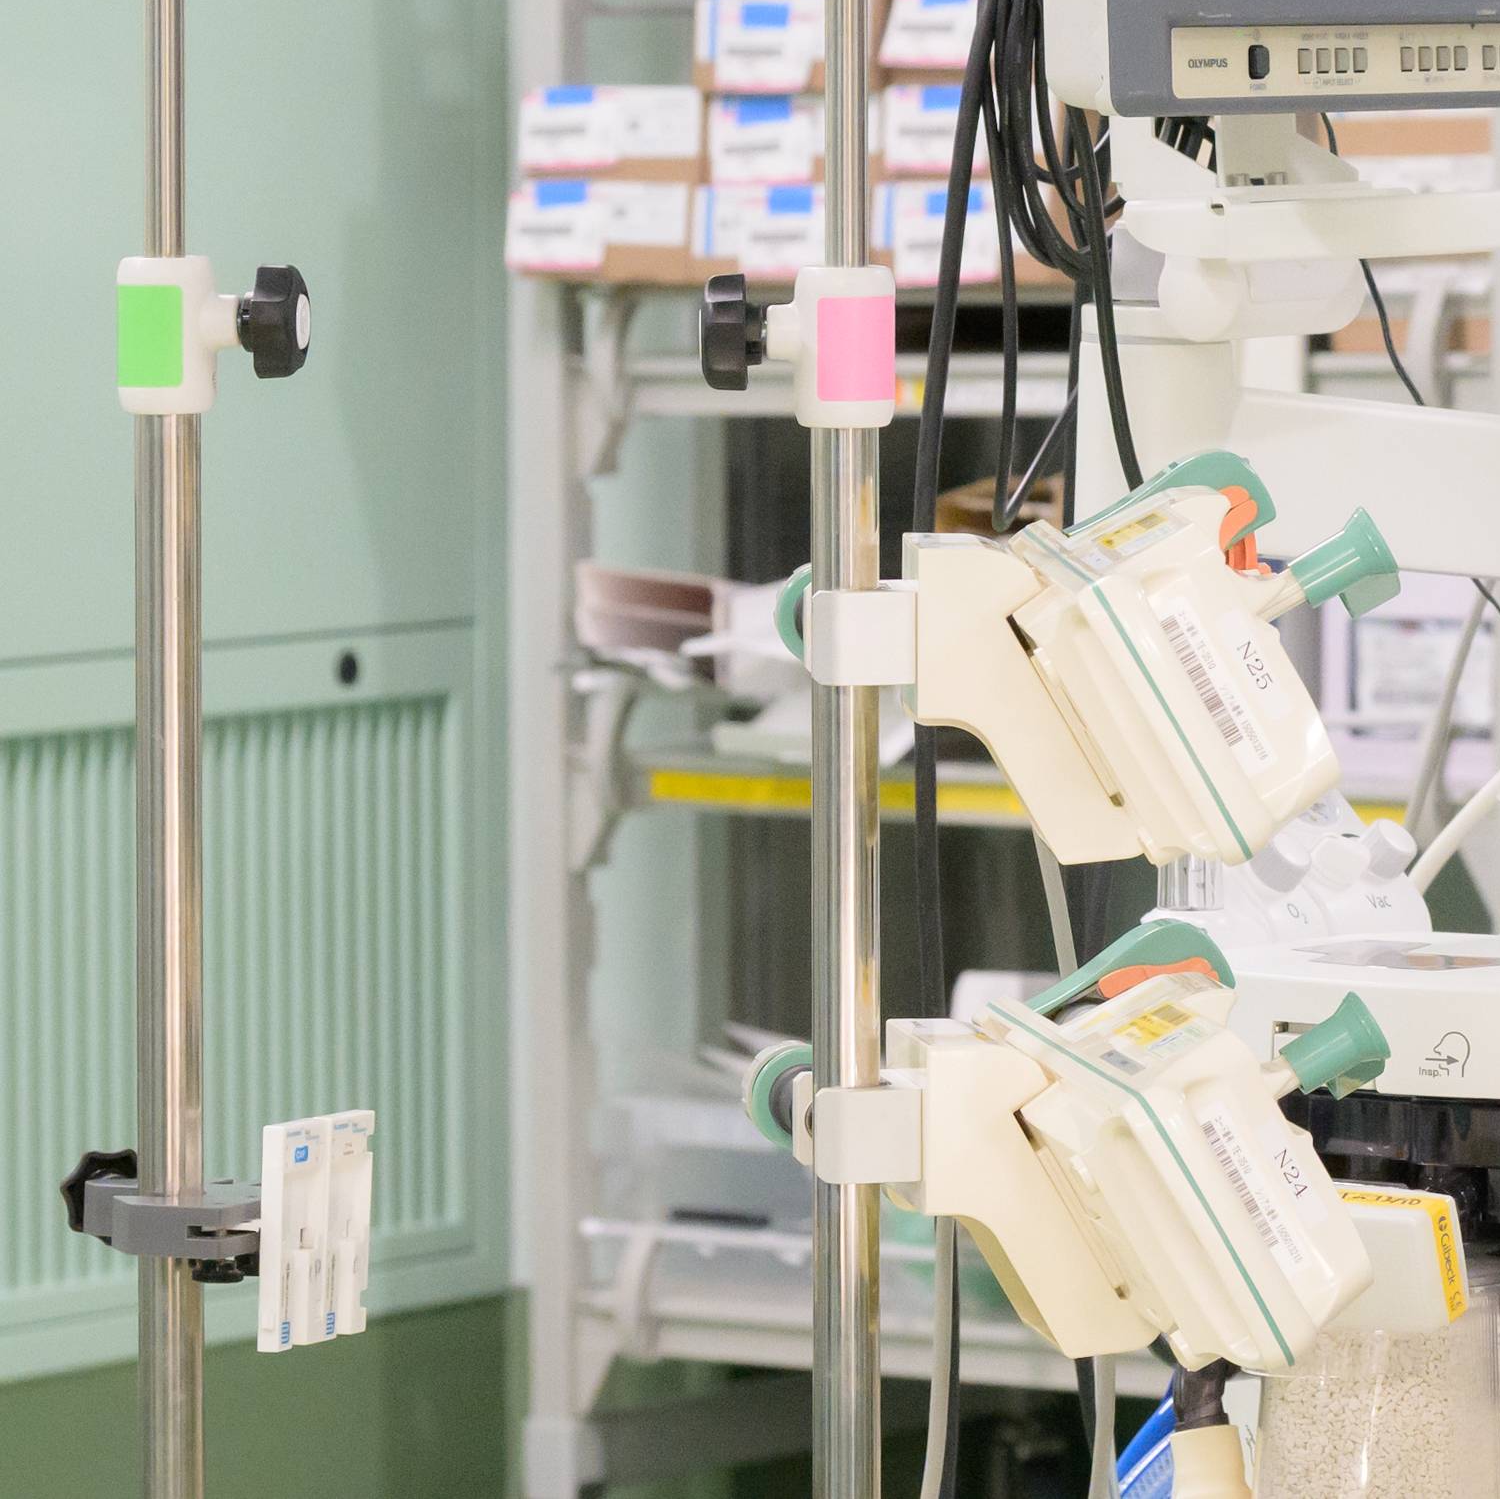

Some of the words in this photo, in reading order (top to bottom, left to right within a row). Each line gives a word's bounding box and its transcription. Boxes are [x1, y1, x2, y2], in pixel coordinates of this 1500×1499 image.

[1187, 57, 1229, 70] OLYMPUS
[1236, 639, 1274, 690] N25
[1365, 894, 1392, 909] Vac
[1286, 902, 1309, 925] O2
[1418, 1065, 1442, 1080] Insp.
[1273, 1148, 1309, 1199] N24
[1440, 1232, 1457, 1286] Gilbeck
